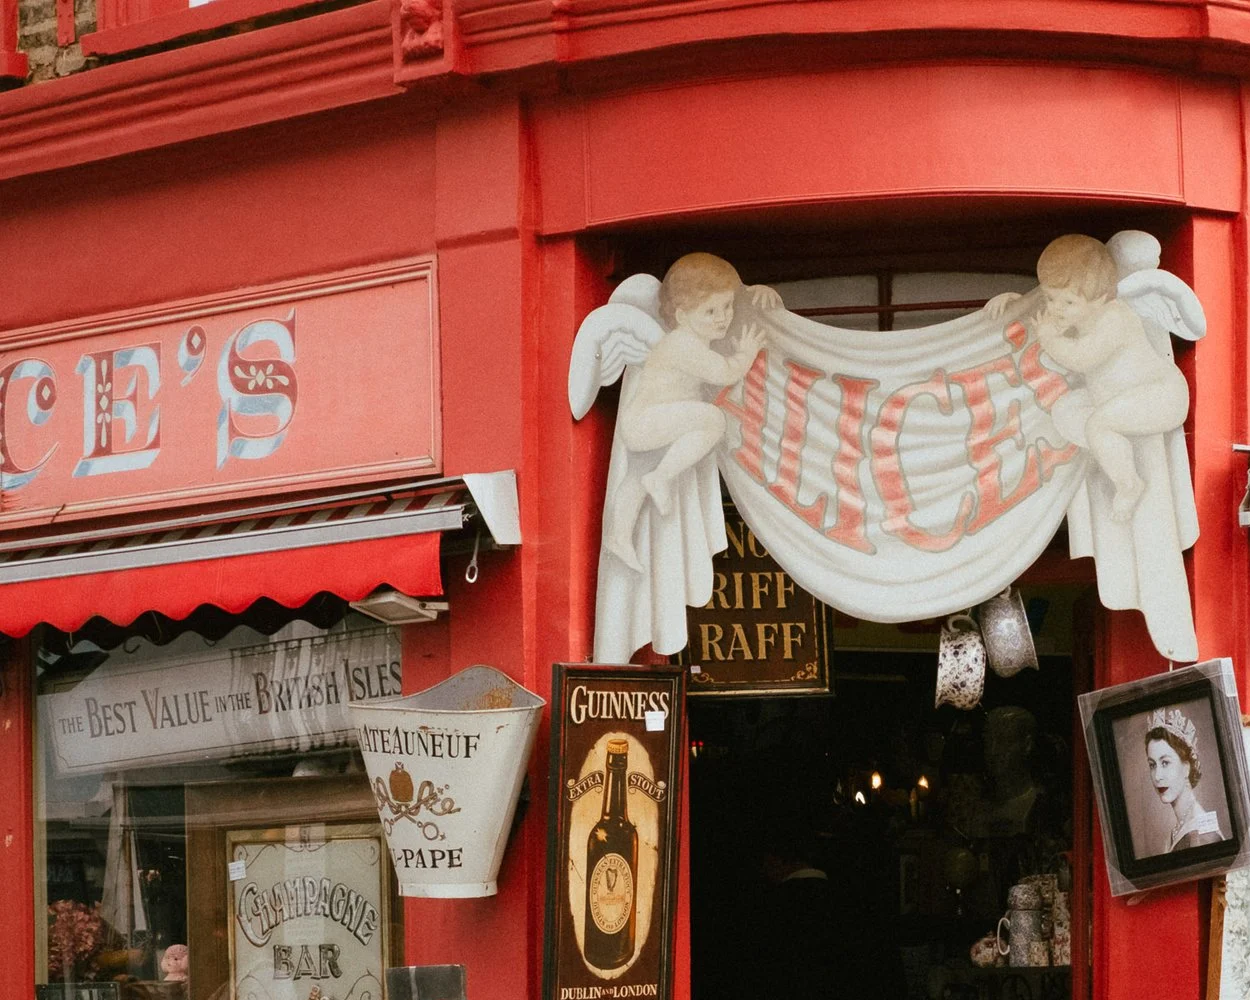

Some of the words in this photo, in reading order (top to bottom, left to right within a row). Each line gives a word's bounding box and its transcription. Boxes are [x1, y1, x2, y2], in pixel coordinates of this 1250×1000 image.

[715, 320, 1080, 556] ALICE'S
[705, 571, 795, 610] RIFF
[699, 622, 806, 661] RAFF
[59, 713, 84, 736] THE
[85, 696, 138, 738] BEST
[141, 687, 213, 730] VALUE
[215, 695, 227, 714] IN
[227, 691, 252, 712] THE
[252, 667, 340, 716] BRITISH
[342, 658, 403, 702] ISLES
[570, 685, 670, 724] GUINNESS
[359, 724, 481, 759] ATEAUNEUF
[570, 773, 602, 799] EXTRA
[630, 773, 664, 799] STOUT
[237, 876, 380, 948] CHAMPAGNE
[273, 943, 343, 981] BAR
[561, 986, 602, 1000] DUBLIN
[614, 984, 658, 998] LONDON
